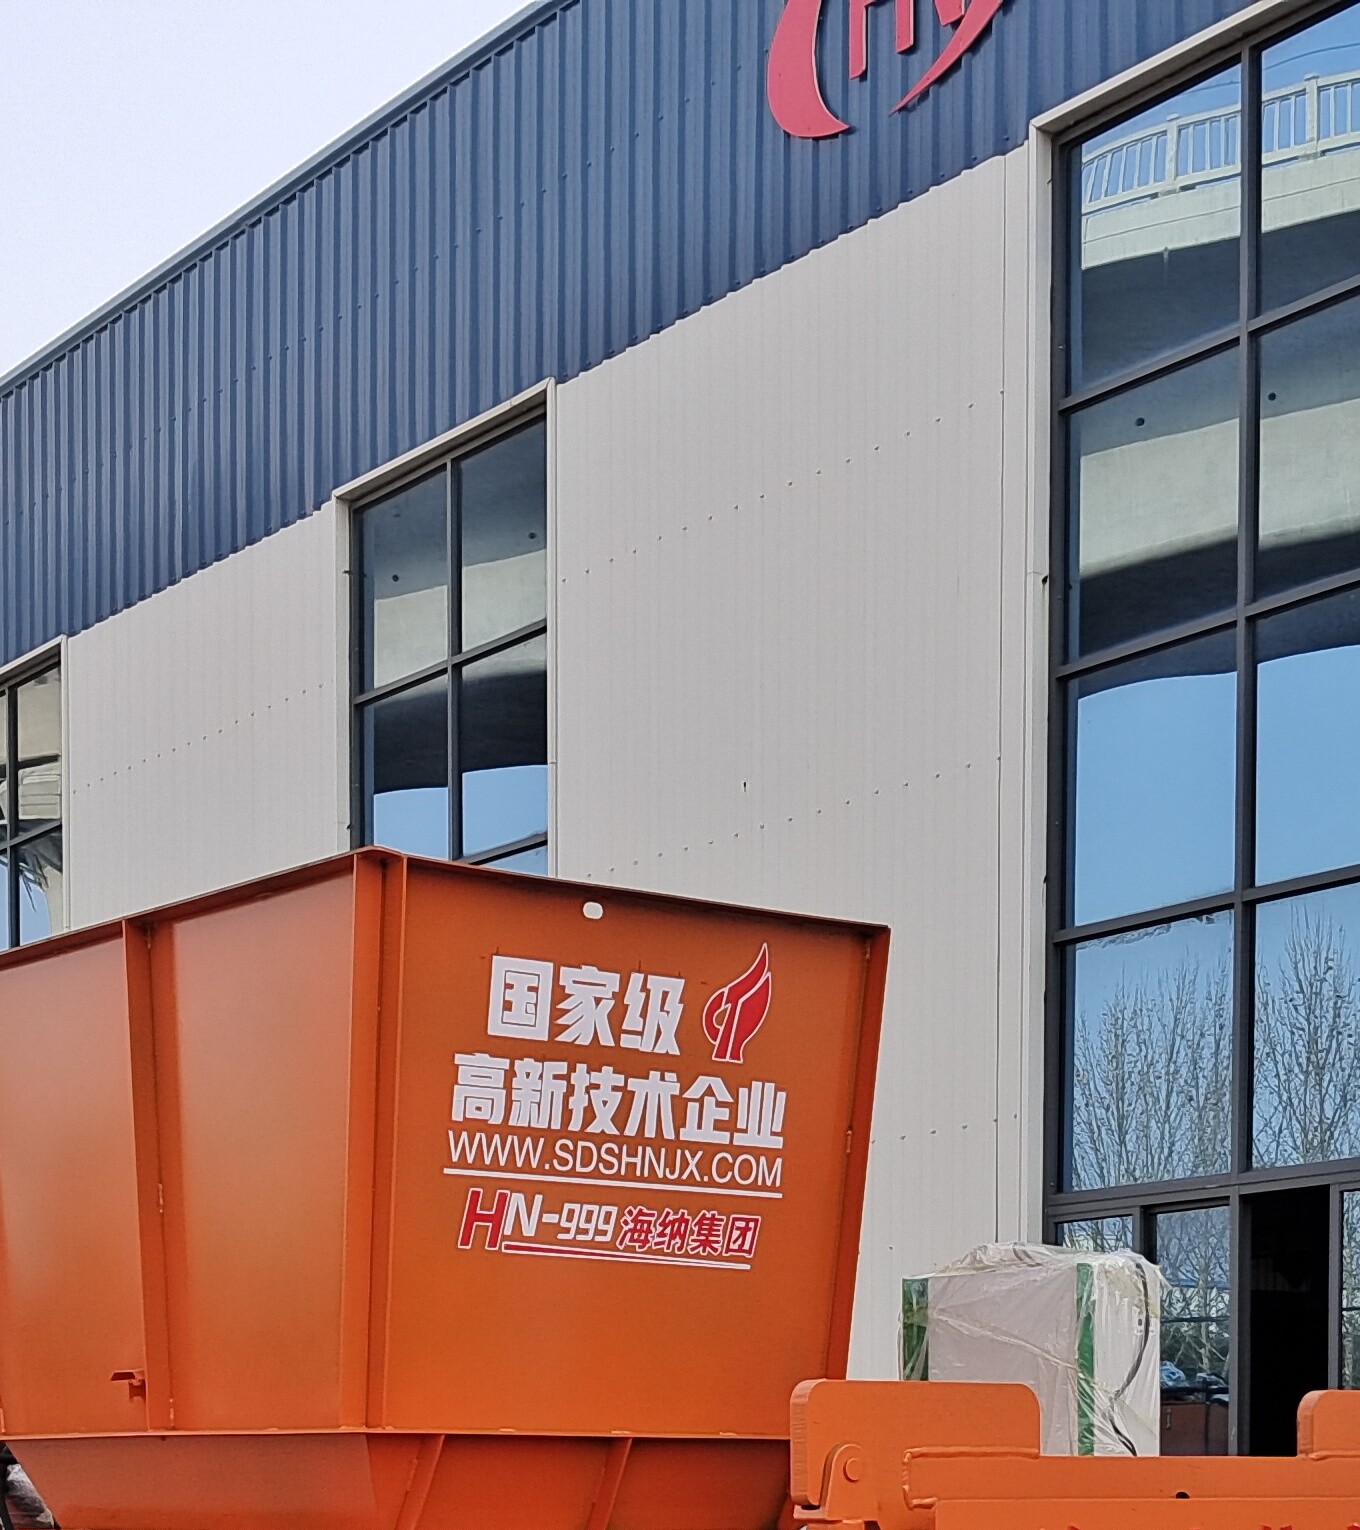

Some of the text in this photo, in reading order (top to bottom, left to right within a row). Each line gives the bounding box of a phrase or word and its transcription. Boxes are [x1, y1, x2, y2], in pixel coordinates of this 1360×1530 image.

[486, 953, 686, 1056] 国家级
[450, 1052, 787, 1149] 高新技术企业
[447, 1130, 783, 1188] WWW.SDSHNJX.COM
[457, 1187, 762, 1258] HN-999 海纳集团
